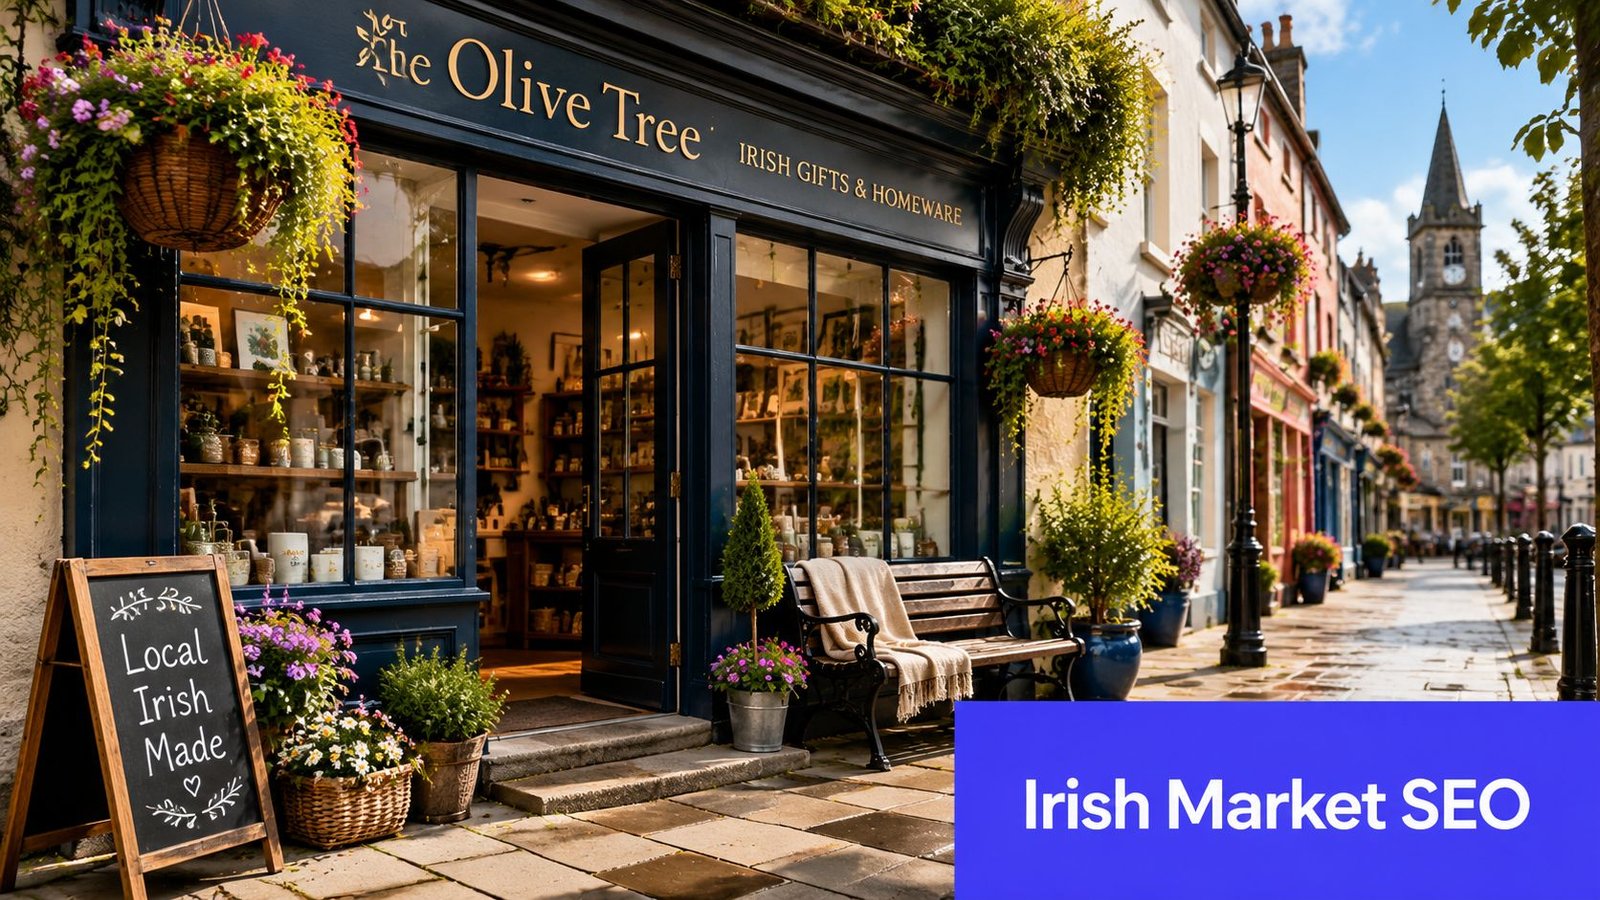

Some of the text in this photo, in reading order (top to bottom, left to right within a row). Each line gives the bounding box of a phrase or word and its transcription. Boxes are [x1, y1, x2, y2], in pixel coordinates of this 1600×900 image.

[447, 37, 592, 129] Olive
[602, 81, 702, 160] Tree
[739, 142, 963, 226] IRISH GIFTS & HOMEWARE
[120, 627, 209, 676] Local
[132, 678, 213, 726] Irish
[144, 725, 227, 777] Made
